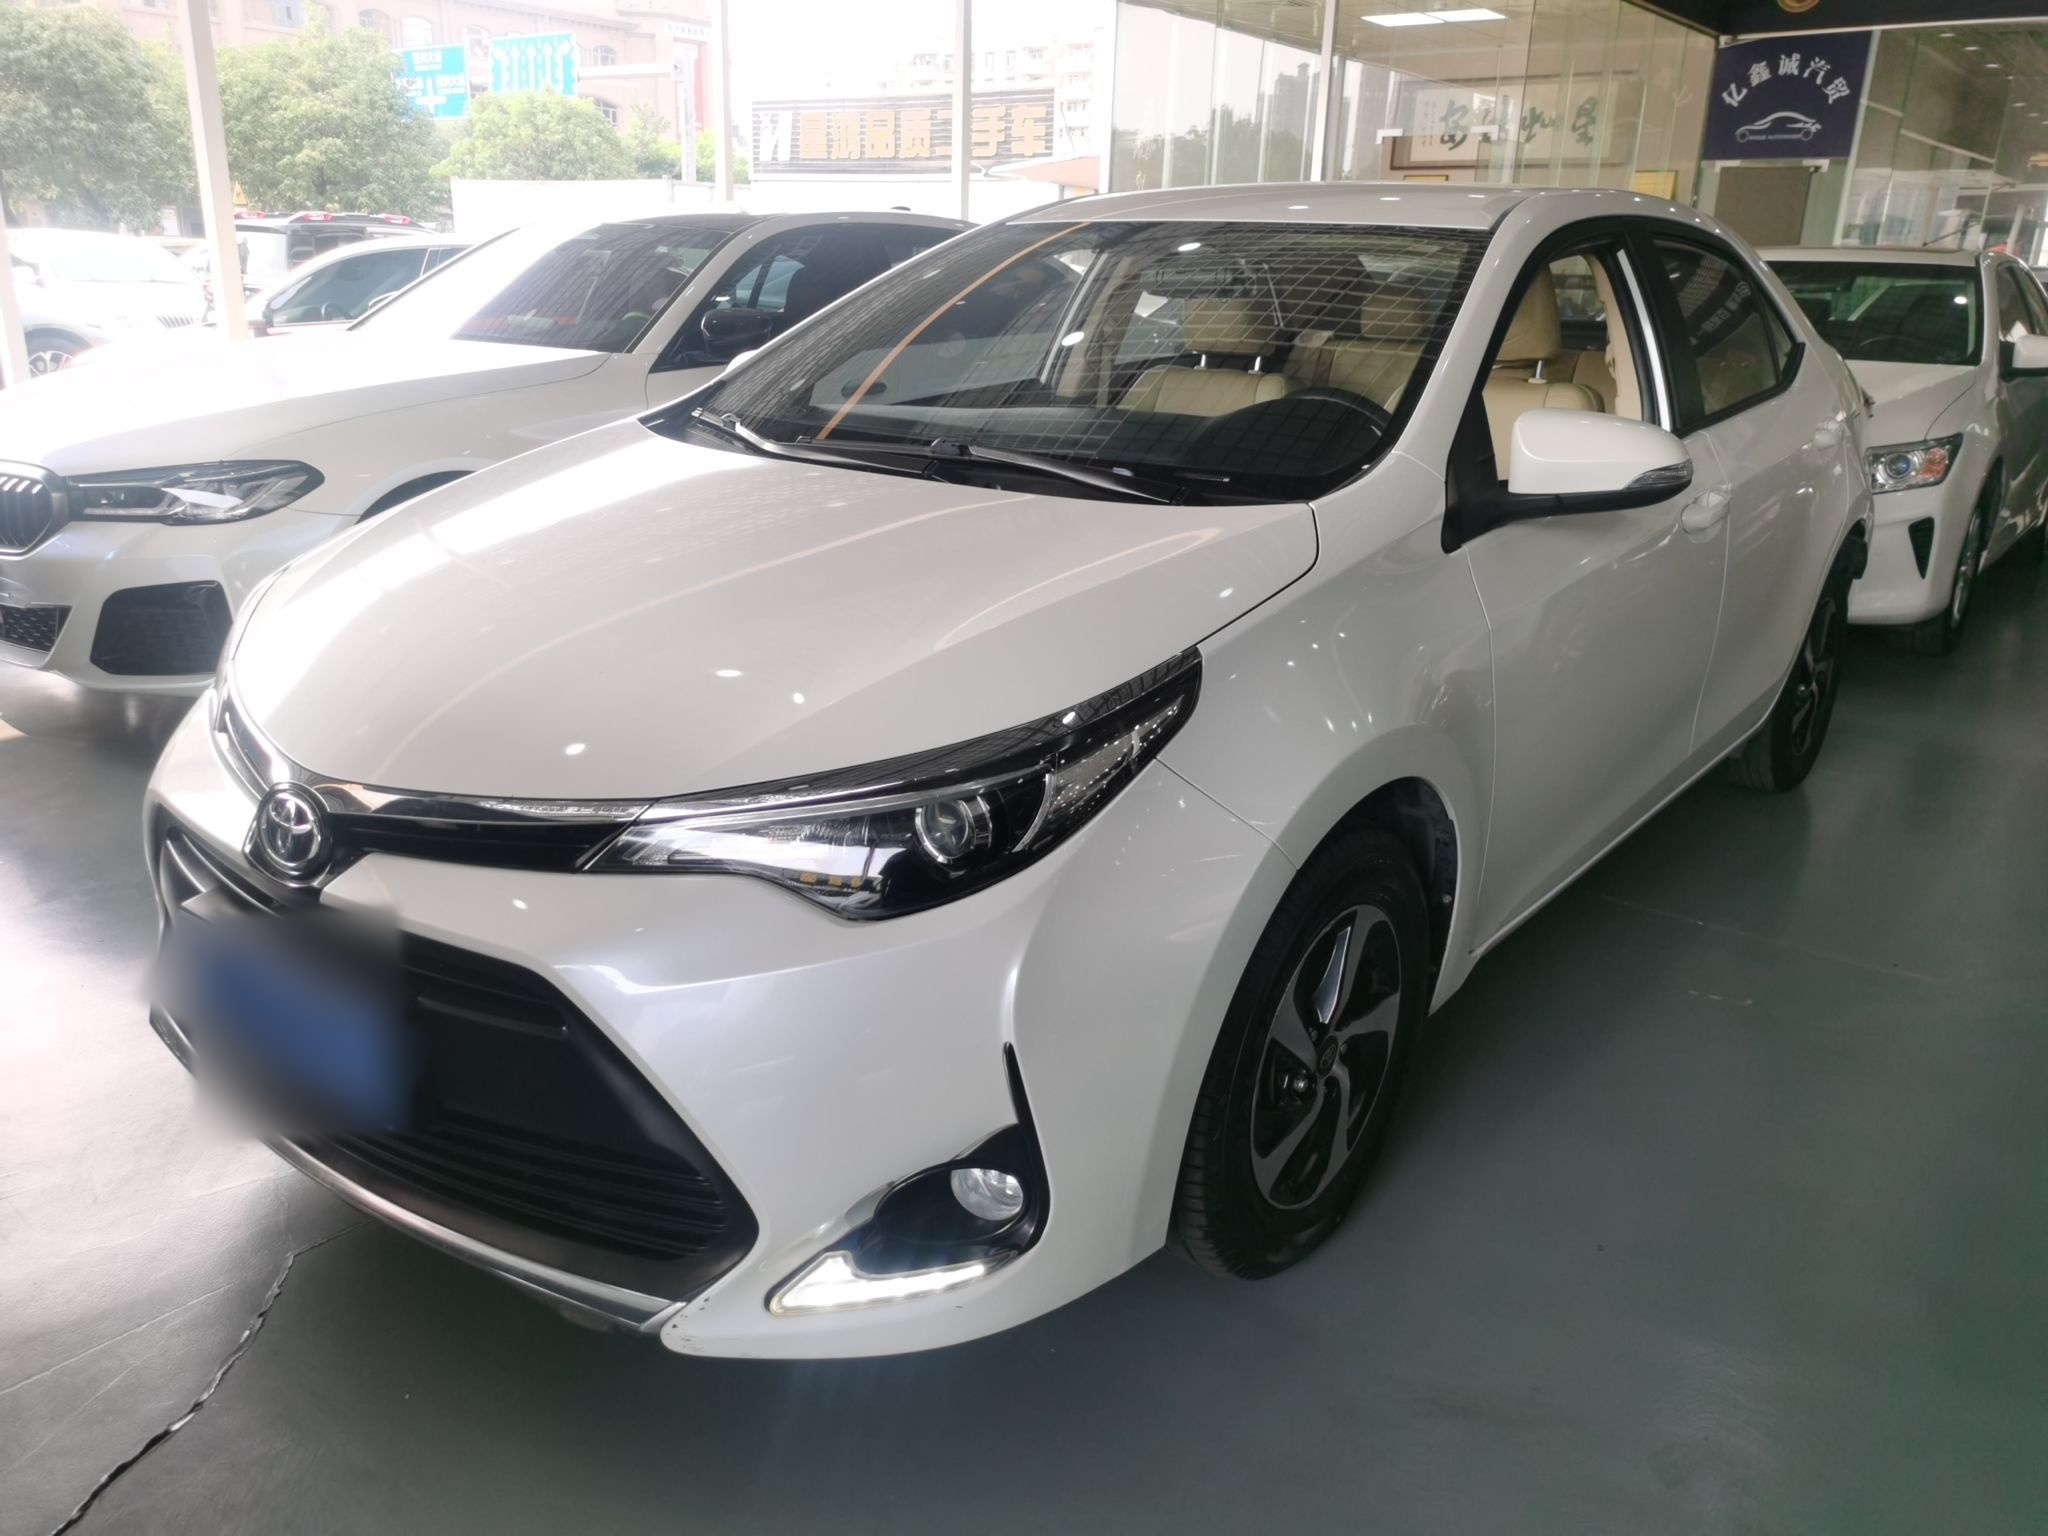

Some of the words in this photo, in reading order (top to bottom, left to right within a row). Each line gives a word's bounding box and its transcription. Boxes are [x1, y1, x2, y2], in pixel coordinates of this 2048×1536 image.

[1721, 52, 1850, 107] 亿鑫诚汽贸
